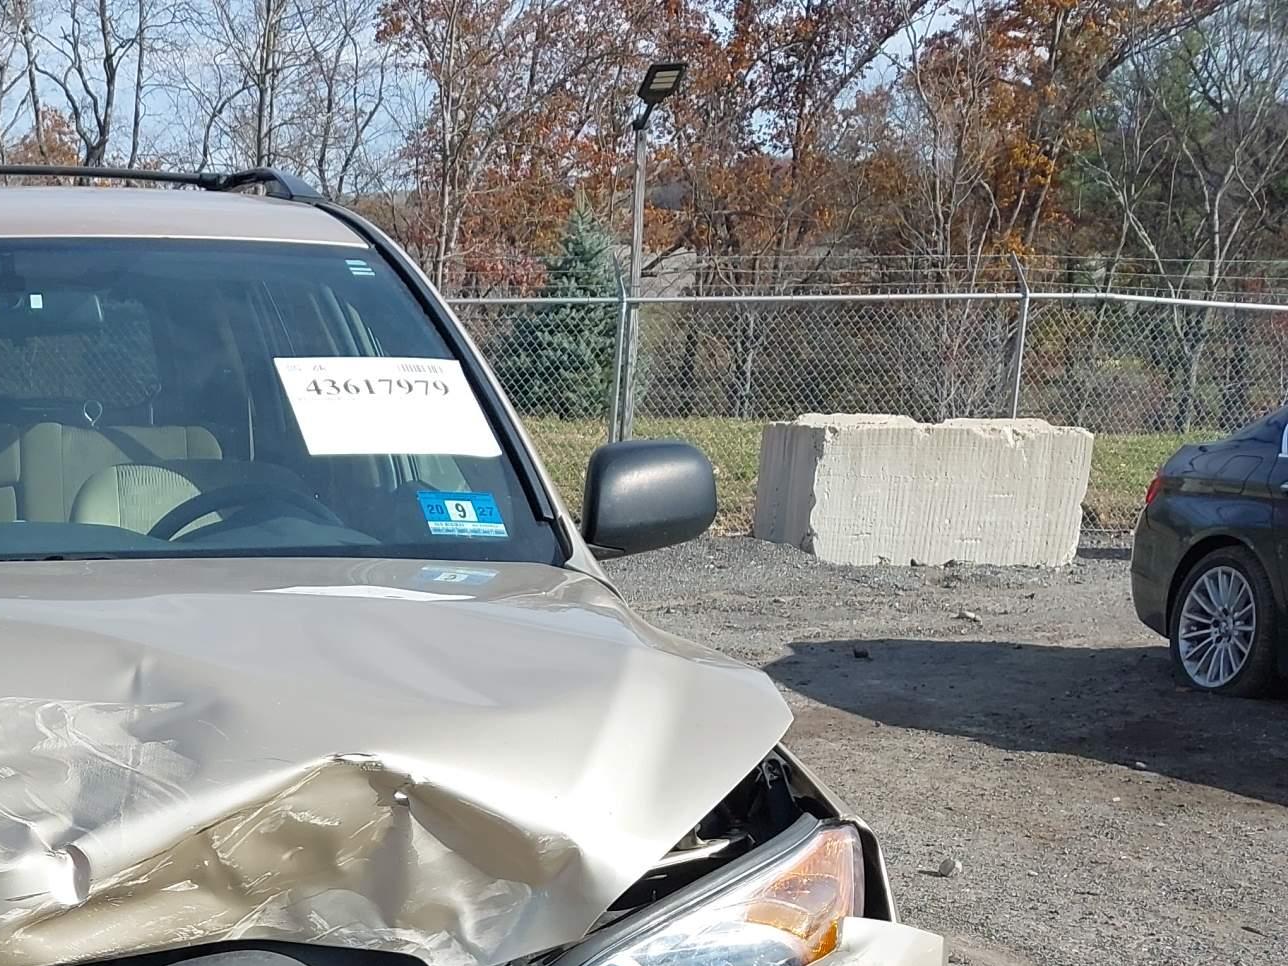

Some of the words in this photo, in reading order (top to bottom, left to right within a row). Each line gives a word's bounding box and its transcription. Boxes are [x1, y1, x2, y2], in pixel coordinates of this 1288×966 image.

[306, 378, 449, 396] 43617979
[427, 503, 444, 515] 20
[455, 502, 467, 519] 9
[478, 506, 494, 517] 27
